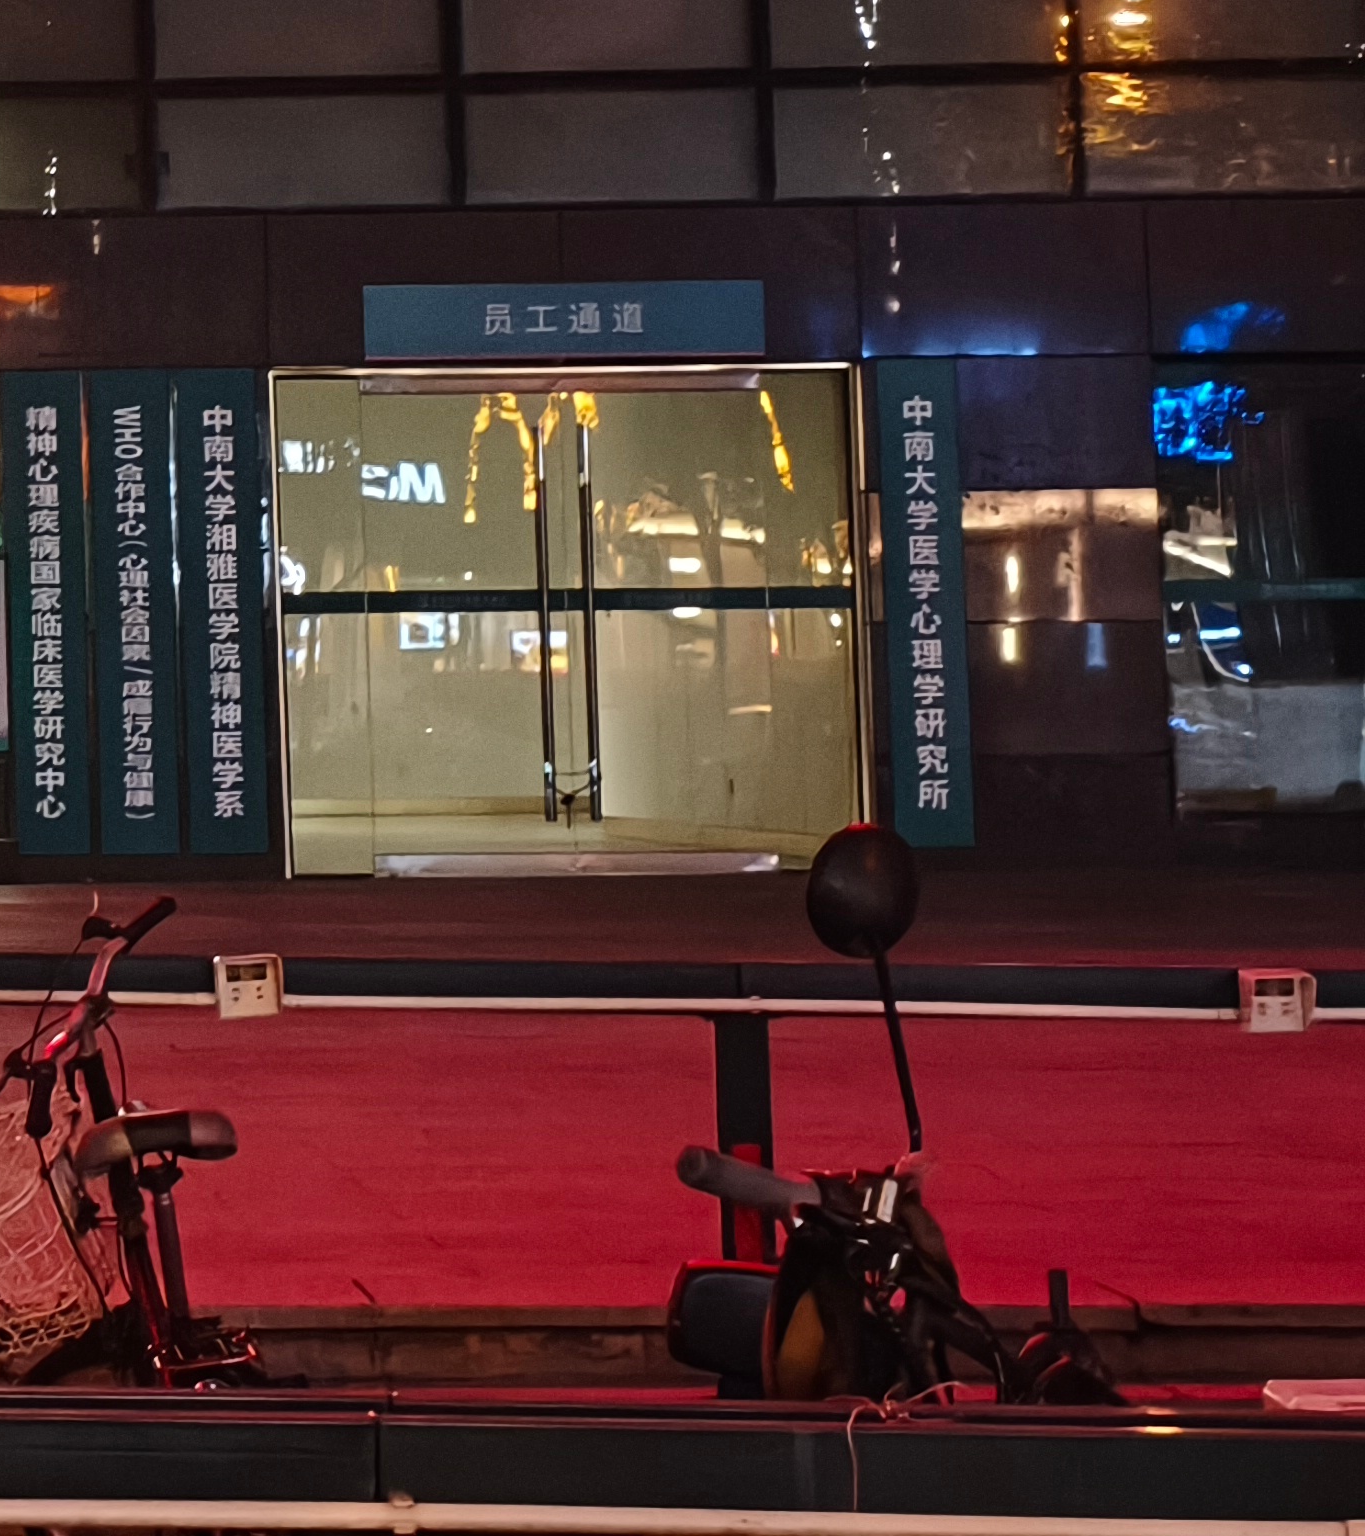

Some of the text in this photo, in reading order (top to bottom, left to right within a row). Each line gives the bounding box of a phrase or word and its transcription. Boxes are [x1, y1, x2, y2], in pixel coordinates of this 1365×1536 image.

[483, 302, 645, 336] 员工通道
[26, 406, 66, 819] 精神心理疾病国家临床医学研究中心
[202, 405, 245, 819] 中南大学湘雅医学院精神医学系
[902, 395, 949, 810] 中南大学医学心理学研究所
